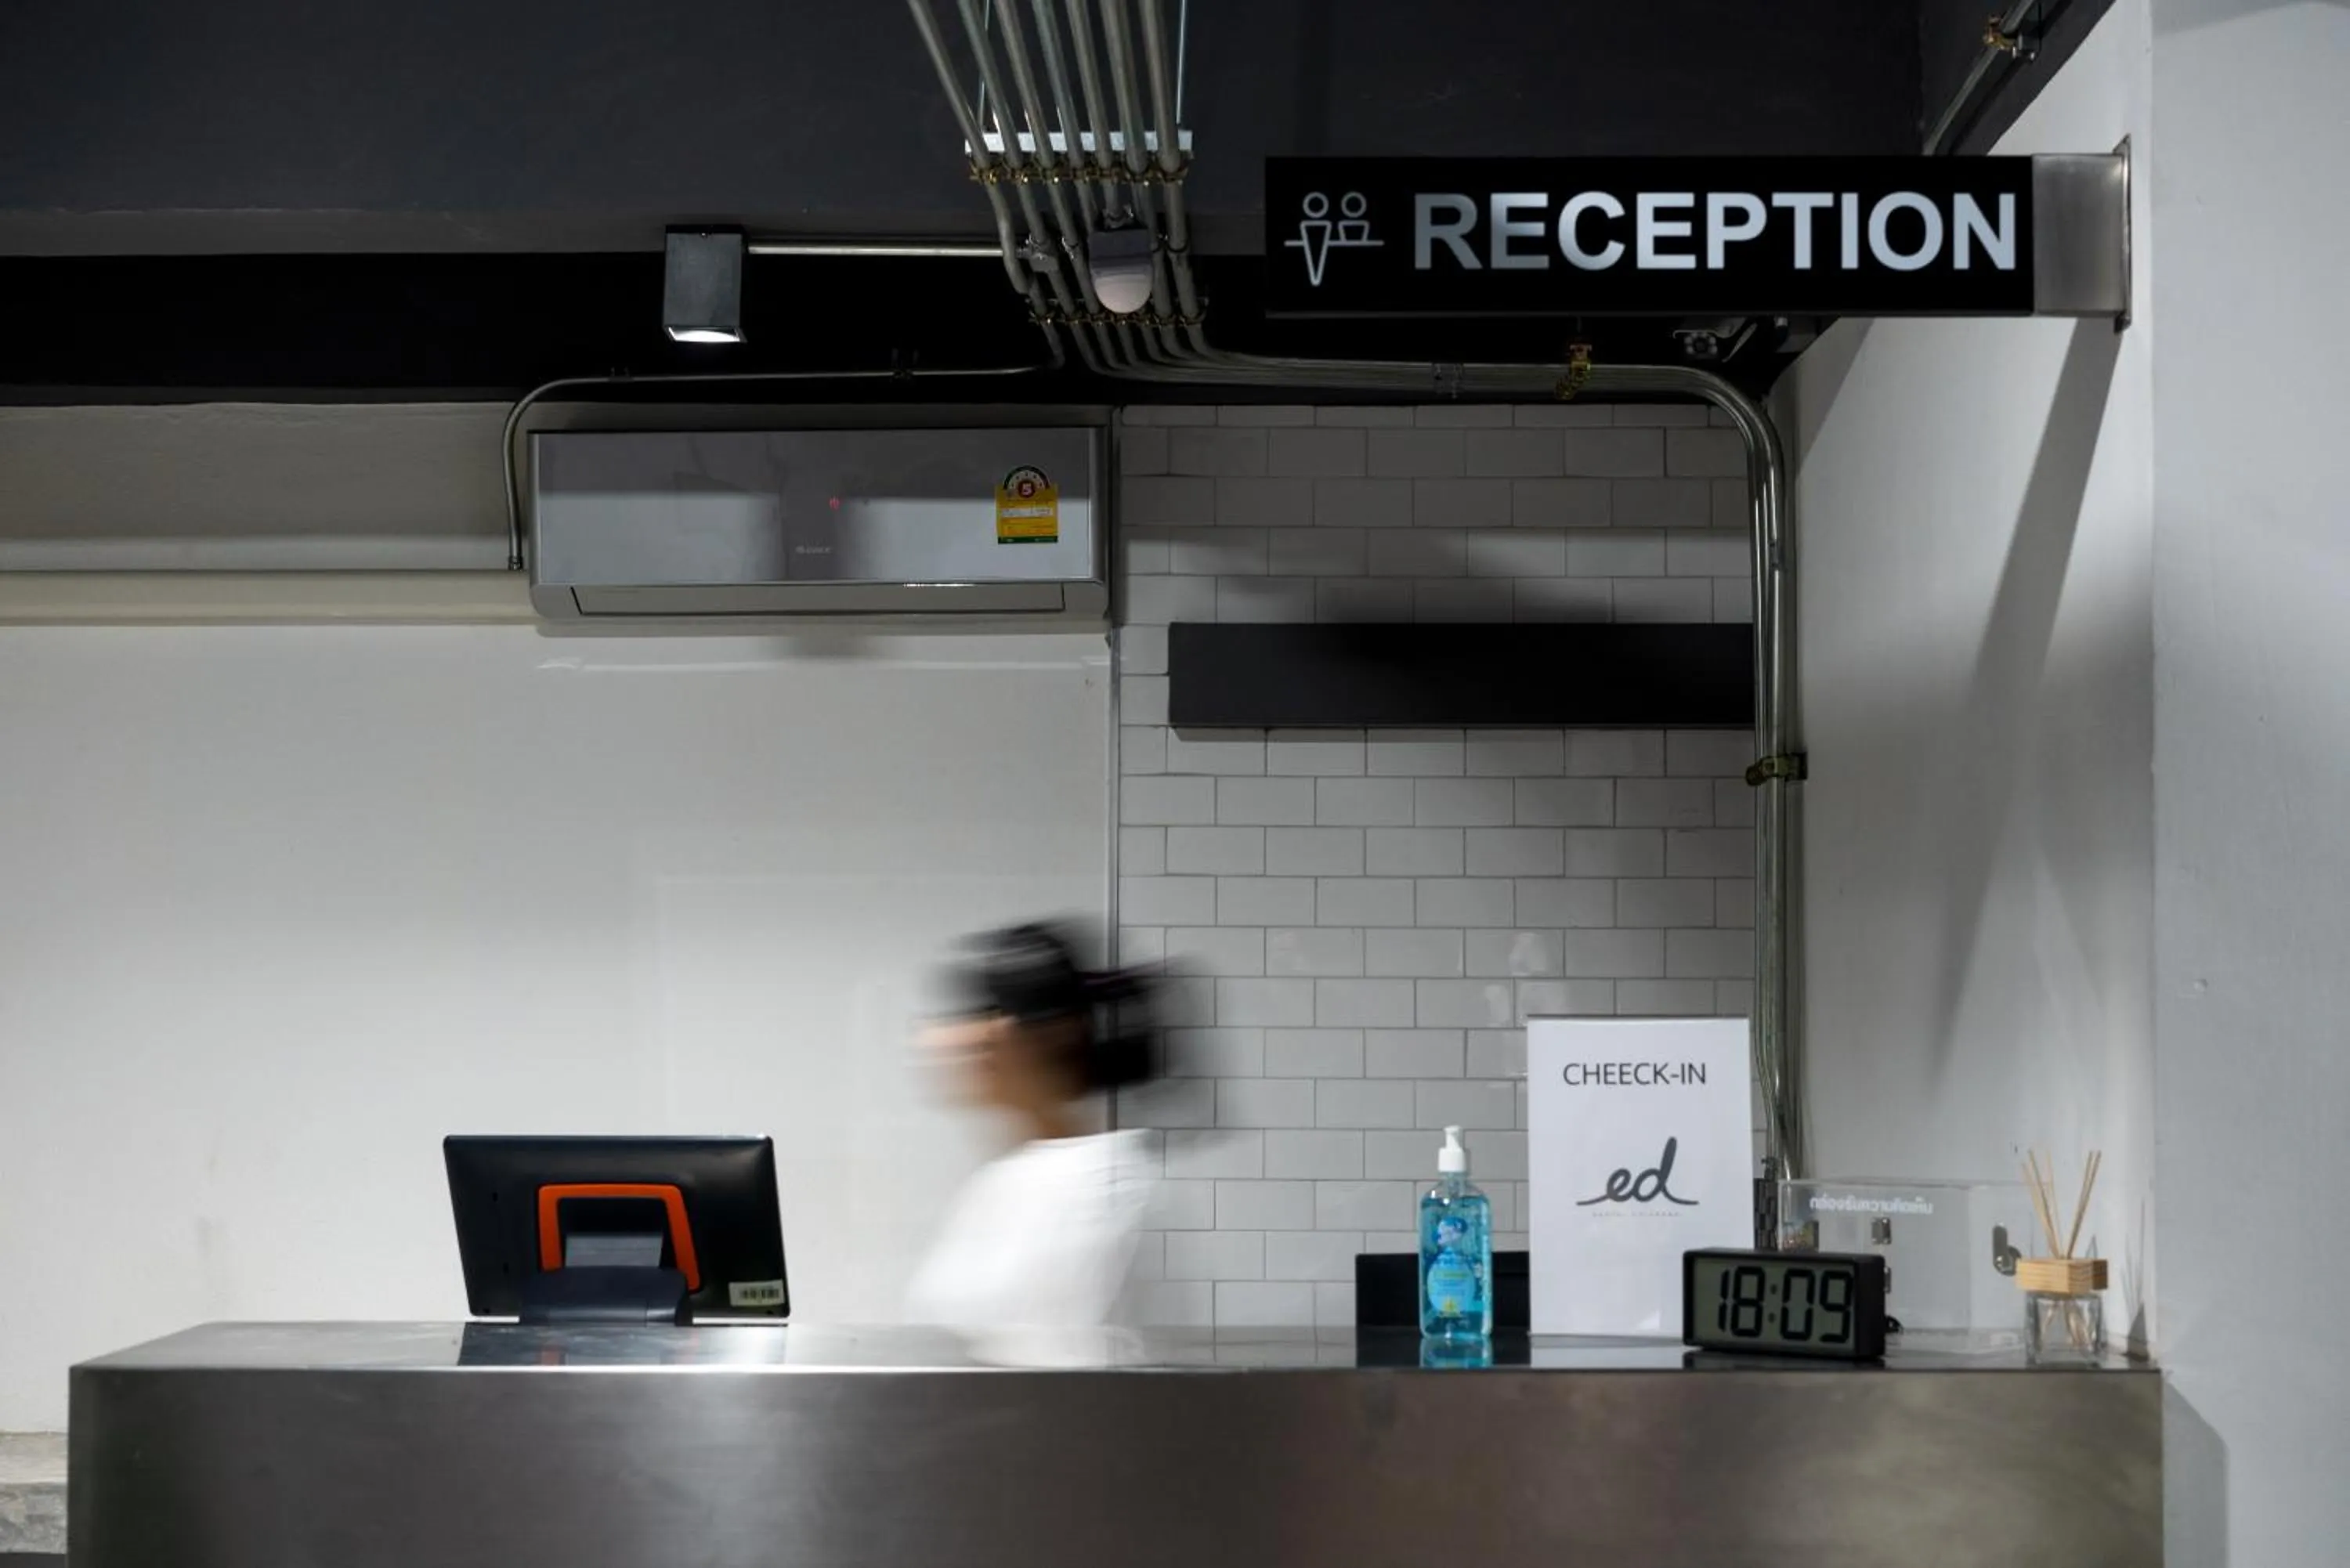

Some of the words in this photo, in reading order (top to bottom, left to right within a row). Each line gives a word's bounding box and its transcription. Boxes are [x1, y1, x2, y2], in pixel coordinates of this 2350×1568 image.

[1414, 191, 2016, 270] RECEPTION
[1563, 1063, 1706, 1085] CHEECK-IN
[1576, 1136, 1699, 1205] ed
[1719, 1266, 1852, 1343] 18:09
